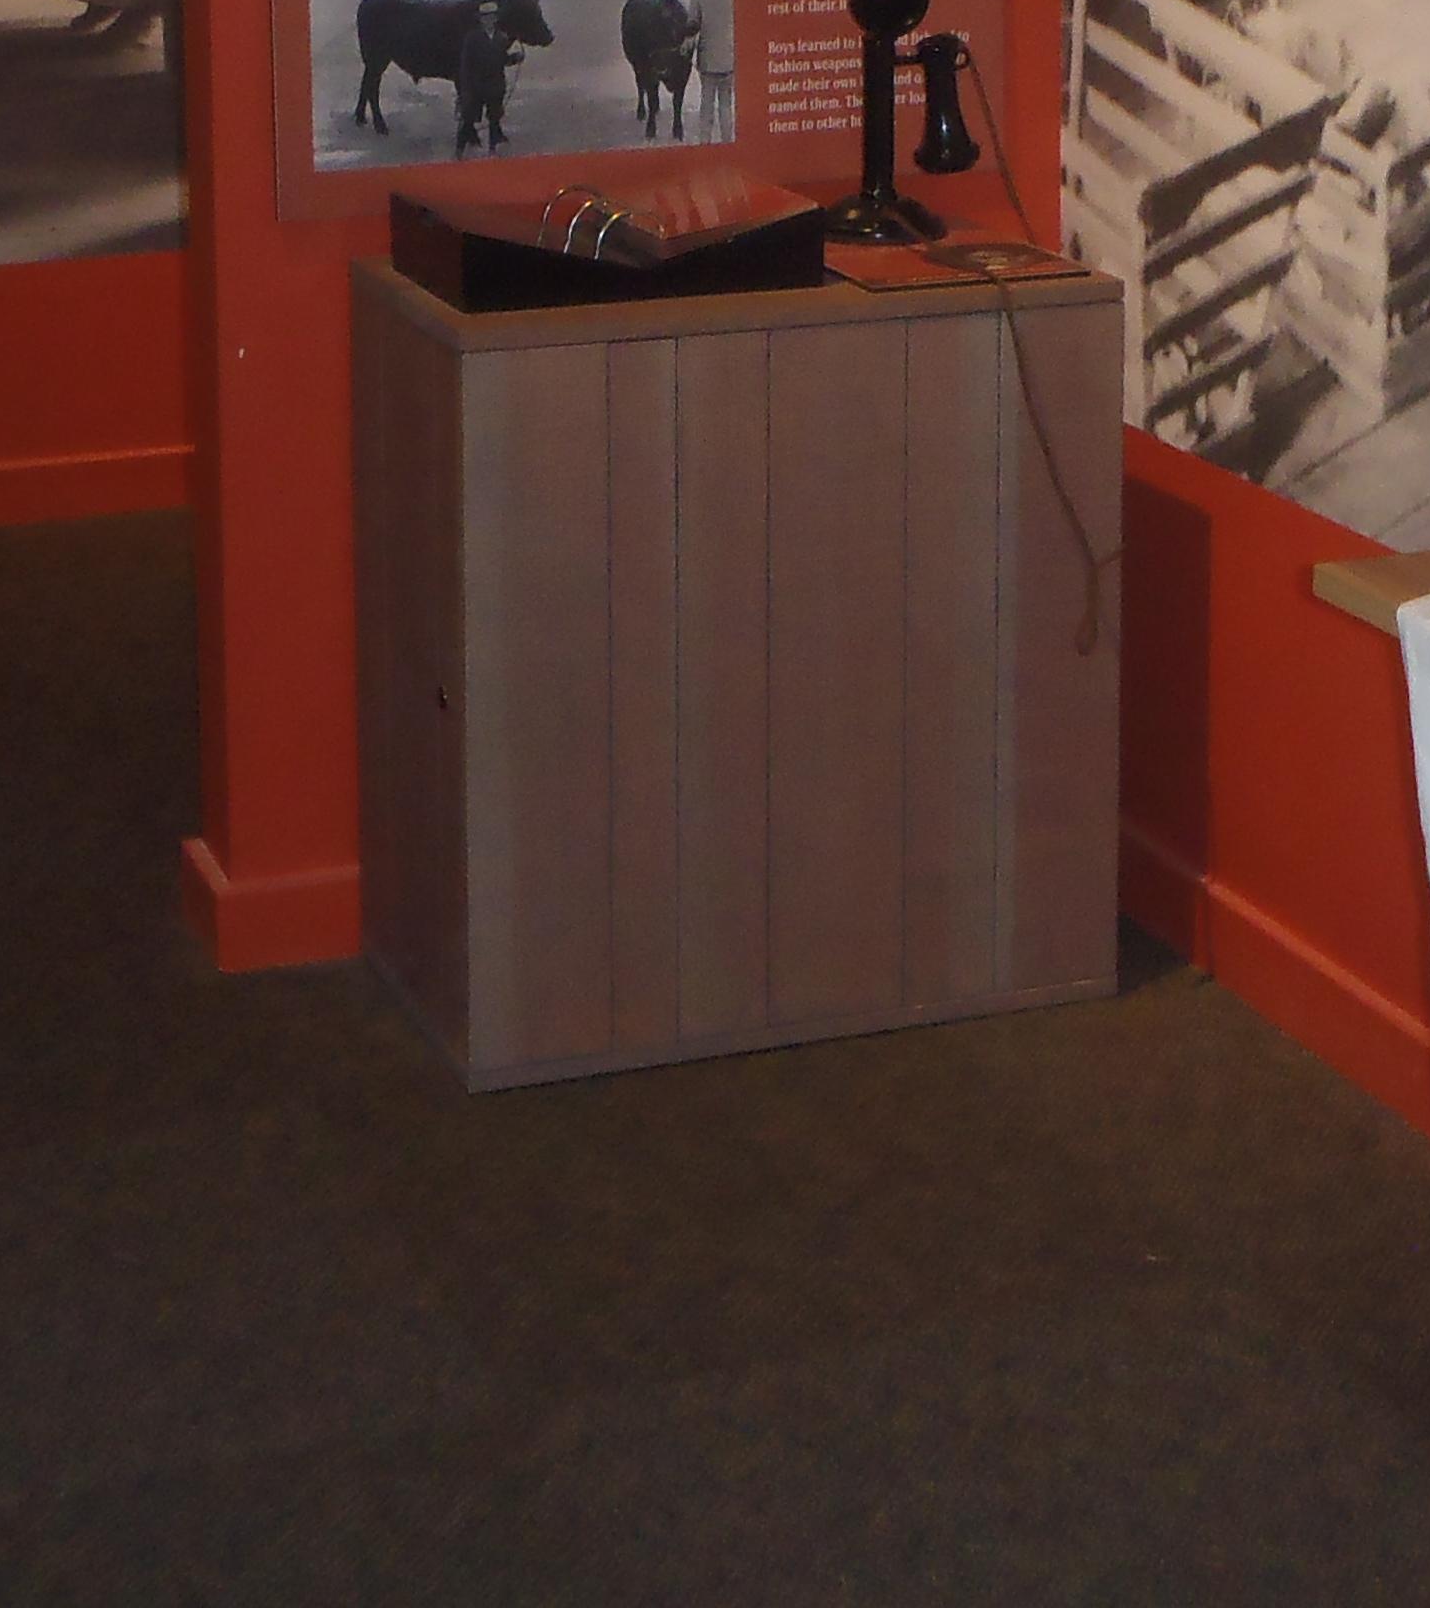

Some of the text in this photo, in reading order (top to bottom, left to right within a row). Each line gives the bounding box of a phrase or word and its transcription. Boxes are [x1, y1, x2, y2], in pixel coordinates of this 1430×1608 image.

[768, 1, 790, 14] rest
[793, 0, 805, 12] of
[768, 38, 855, 54] Boys learned to
[768, 59, 810, 73] fashion
[769, 77, 856, 94] made their own
[769, 97, 807, 113] named
[769, 116, 846, 132] them to other
